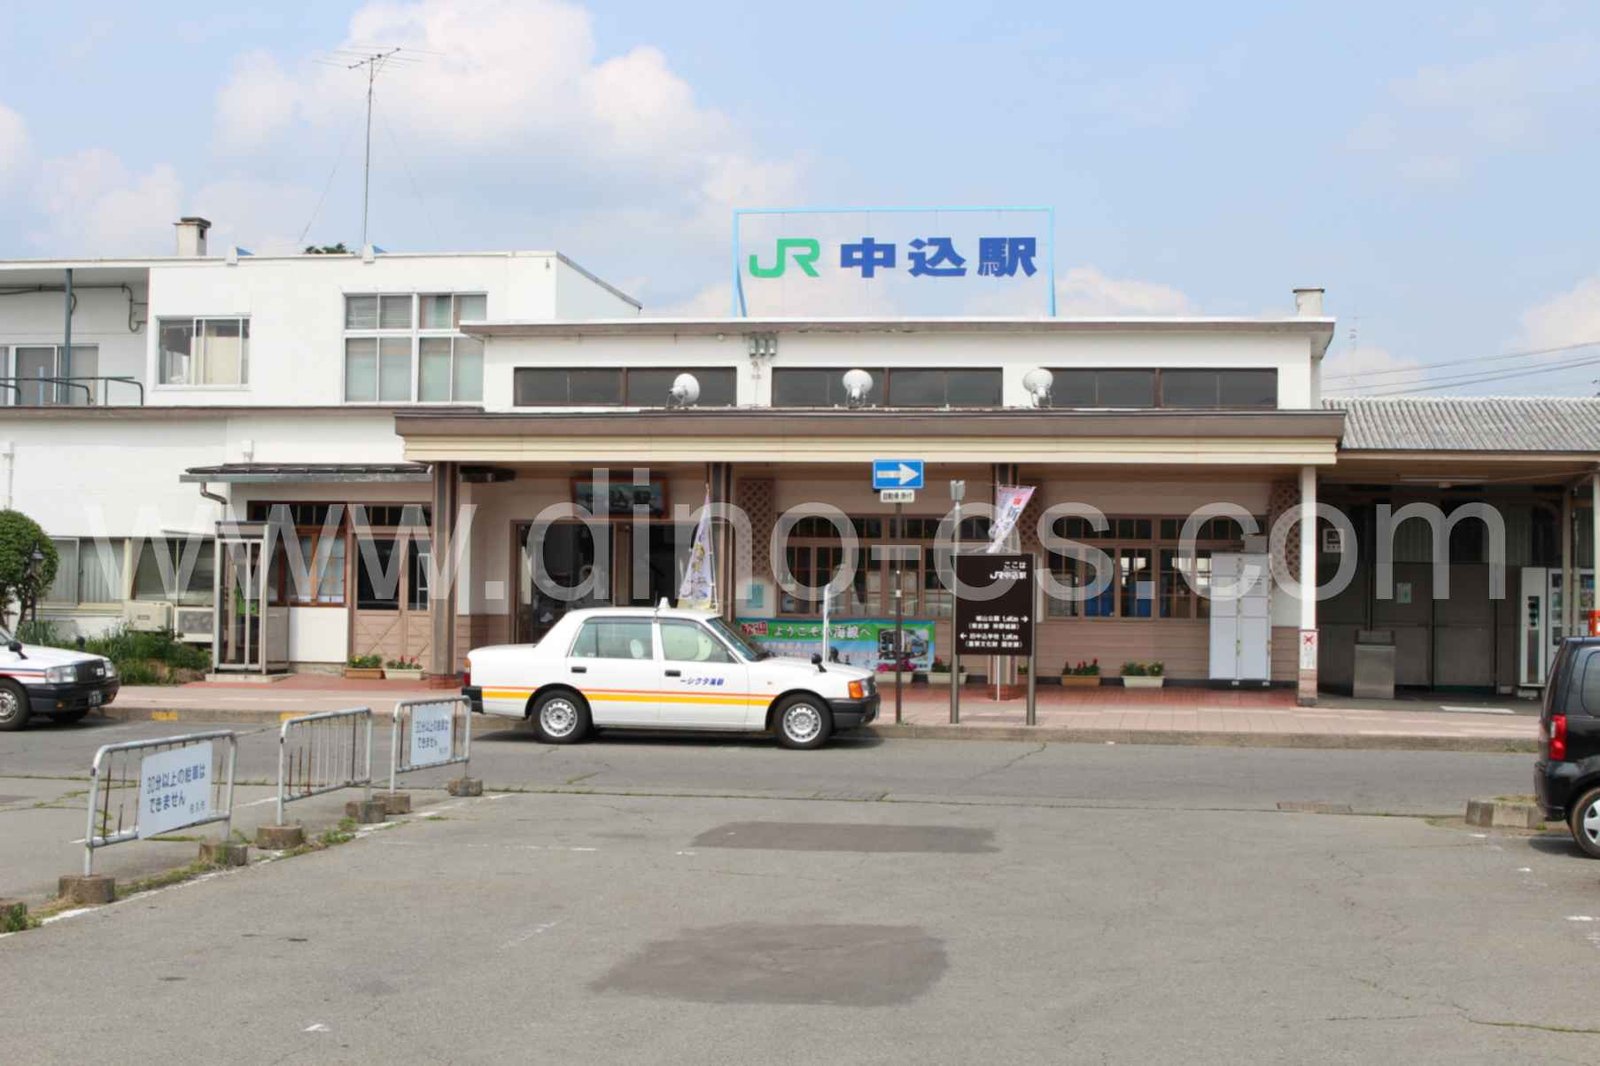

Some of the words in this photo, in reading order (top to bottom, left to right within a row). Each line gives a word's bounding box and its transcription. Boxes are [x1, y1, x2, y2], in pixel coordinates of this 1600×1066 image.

[749, 238, 820, 278] JR
[840, 236, 1037, 277] 中込駅
[1004, 561, 1026, 570] ここは
